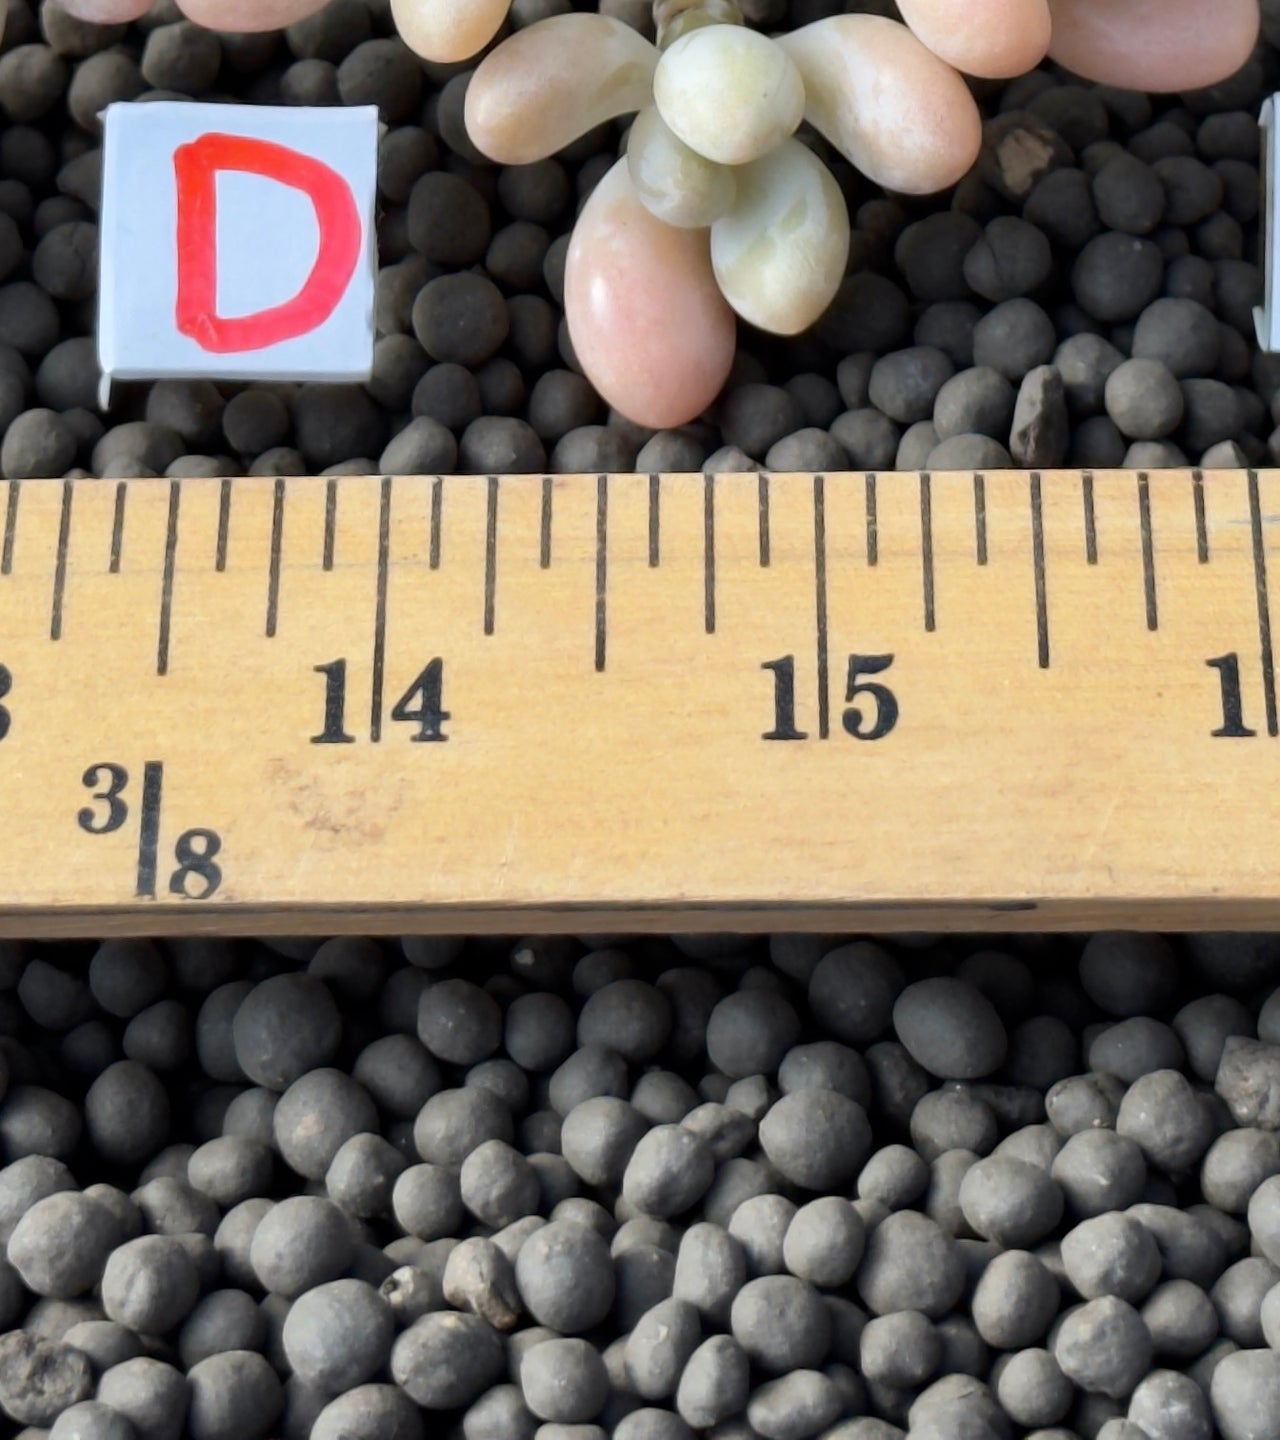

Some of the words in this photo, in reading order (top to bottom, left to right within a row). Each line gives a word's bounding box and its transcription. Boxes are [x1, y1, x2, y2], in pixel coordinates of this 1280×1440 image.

[174, 133, 363, 352] D
[310, 657, 451, 744] 14
[761, 654, 900, 741] 15
